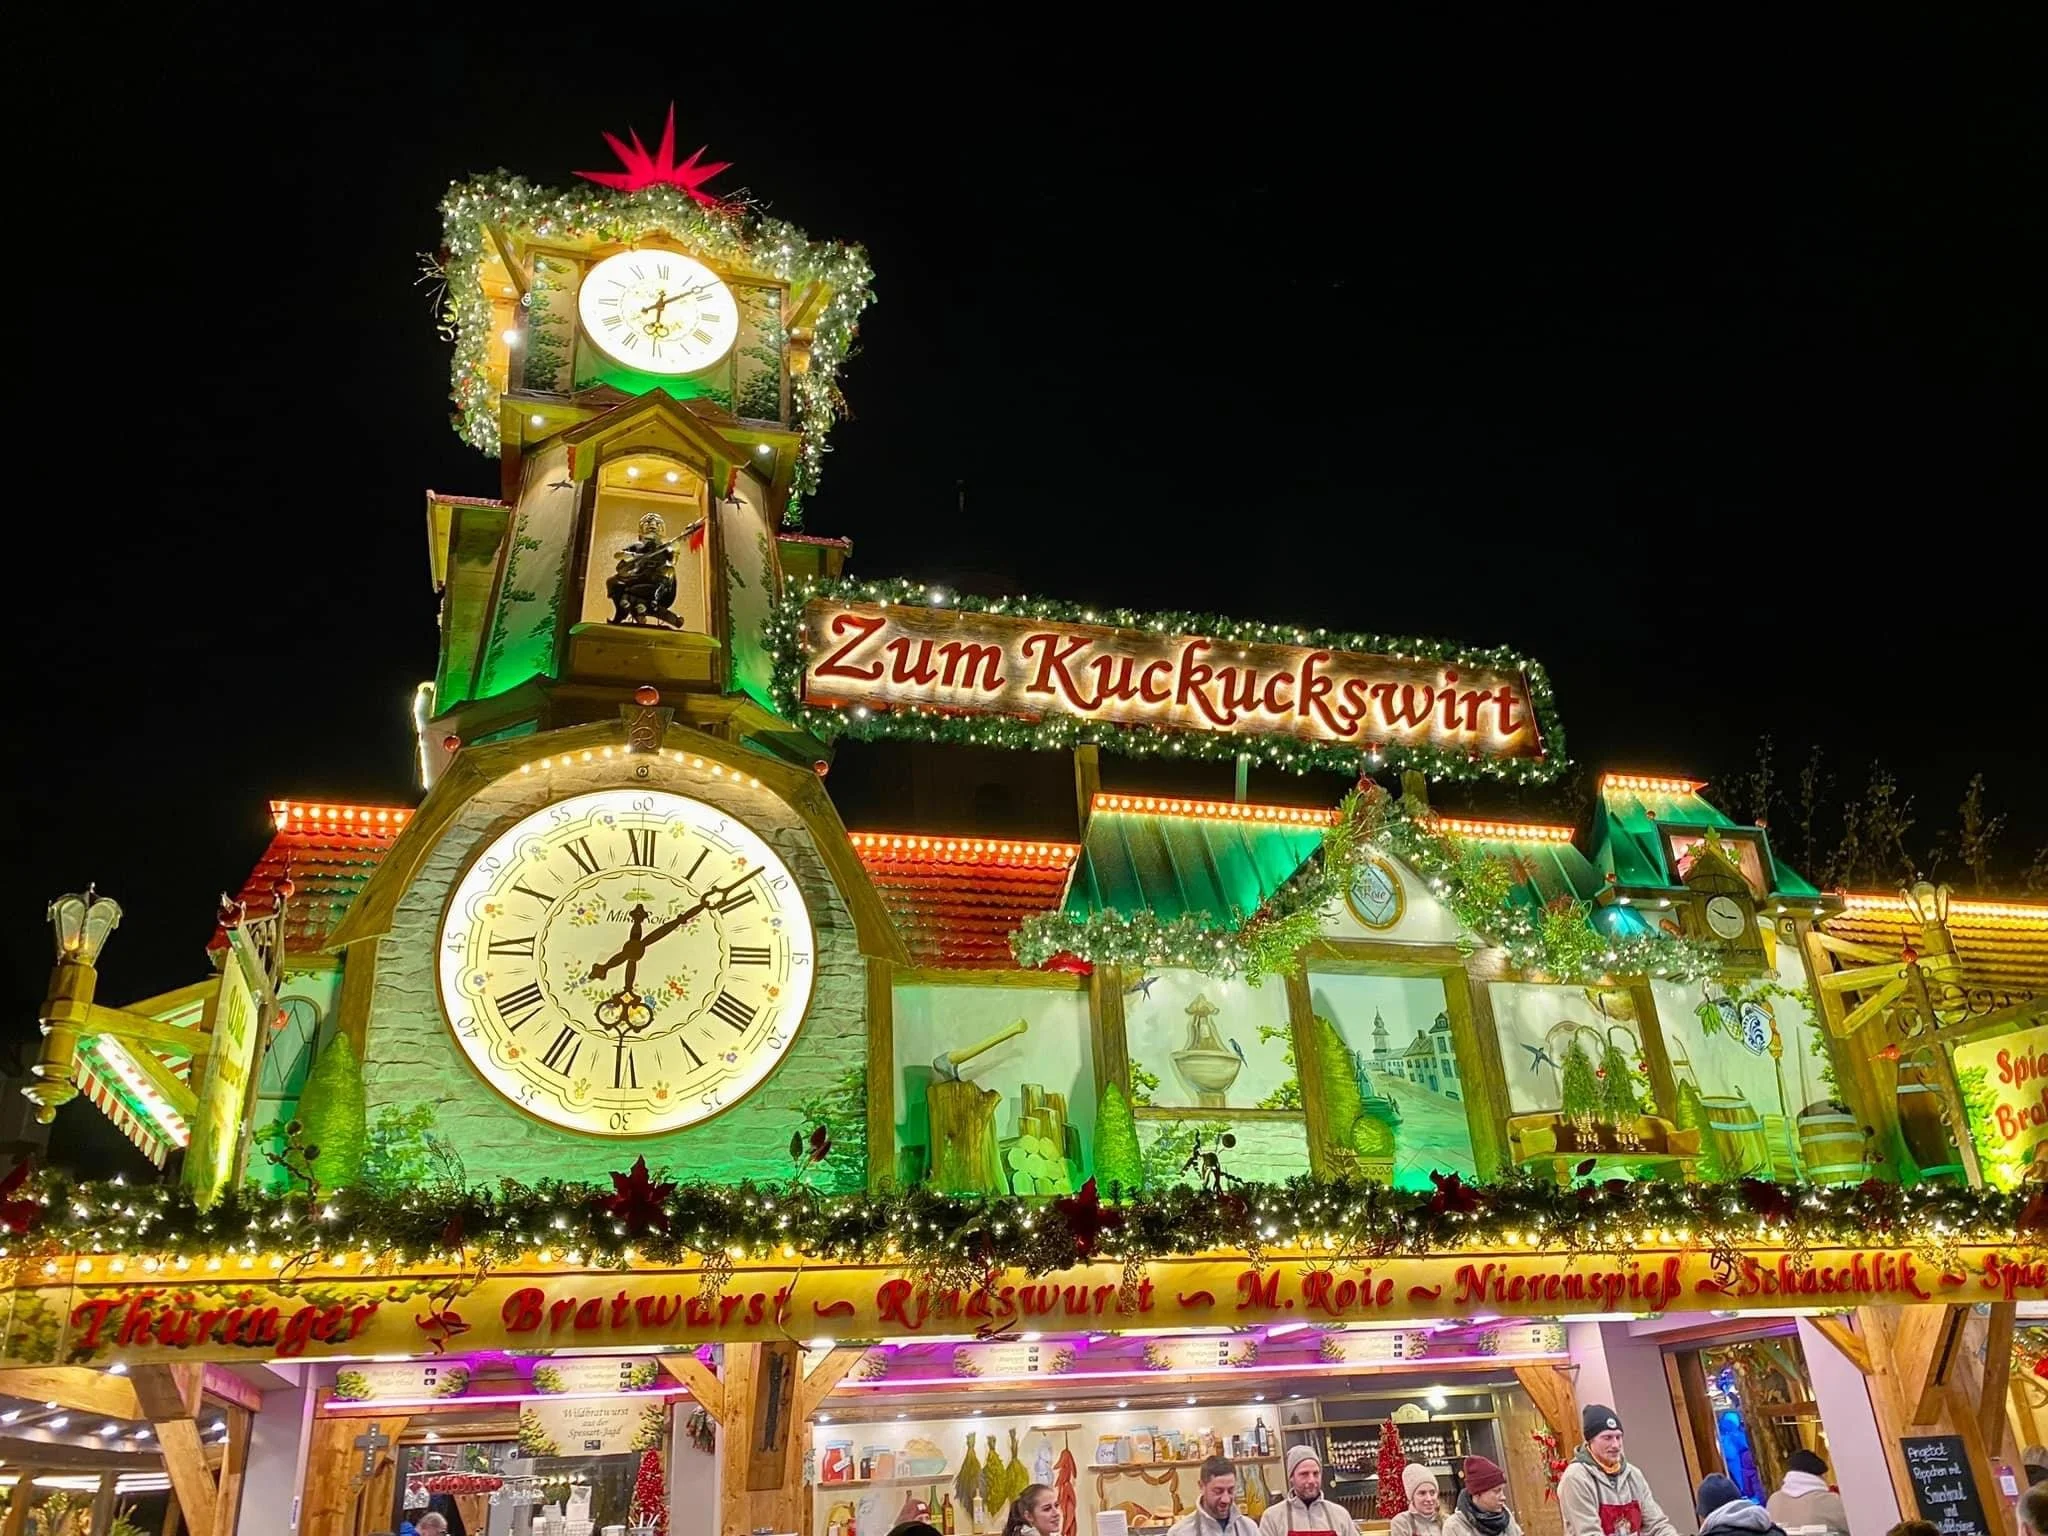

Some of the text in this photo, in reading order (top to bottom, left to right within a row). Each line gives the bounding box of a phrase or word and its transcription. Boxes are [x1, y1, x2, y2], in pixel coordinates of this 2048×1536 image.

[814, 614, 1523, 737] Zum Kuckuckswirt
[632, 796, 654, 812] 60
[550, 806, 572, 826] 55
[713, 818, 728, 834] 5
[623, 828, 660, 868] XII
[479, 856, 501, 878] 50
[770, 874, 789, 892] 10
[606, 909, 635, 923] Mik
[446, 931, 466, 954] 45
[792, 951, 809, 967] 15
[609, 1111, 631, 1131] 30
[71, 1287, 379, 1357] Thüringer
[502, 1284, 793, 1333] Bratwurst
[1236, 1267, 1294, 1311] M.
[1301, 1267, 1395, 1317] Roie
[1454, 1256, 1683, 1312] Nierenspieß
[1737, 1251, 1932, 1301] Schaschlik
